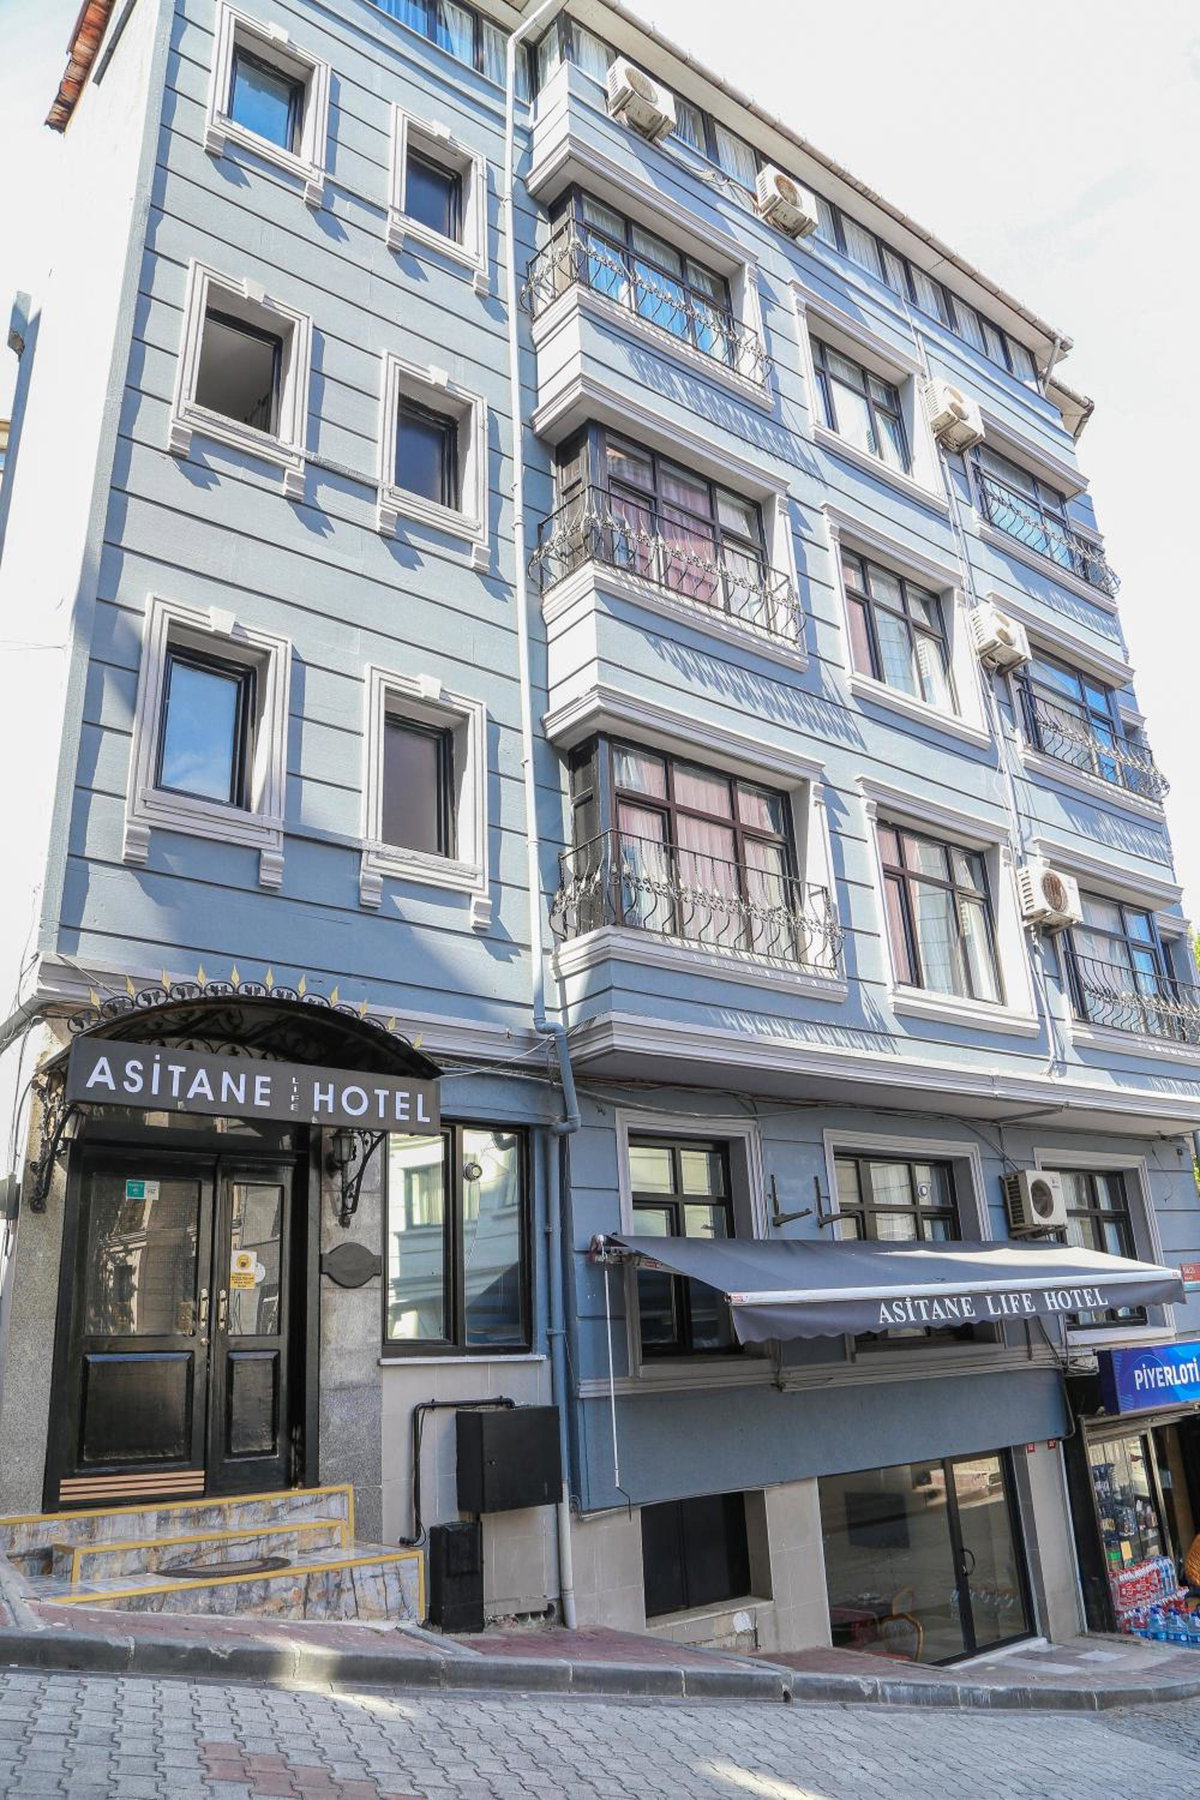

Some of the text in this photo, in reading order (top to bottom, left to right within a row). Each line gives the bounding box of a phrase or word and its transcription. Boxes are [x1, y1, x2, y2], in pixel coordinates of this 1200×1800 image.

[85, 1054, 272, 1107] ASİTANE
[313, 1081, 431, 1123] HOTEL
[879, 1287, 1109, 1325] ASİTANE LIFE HOTEL
[1134, 1356, 1200, 1390] PİYERLOTİ
